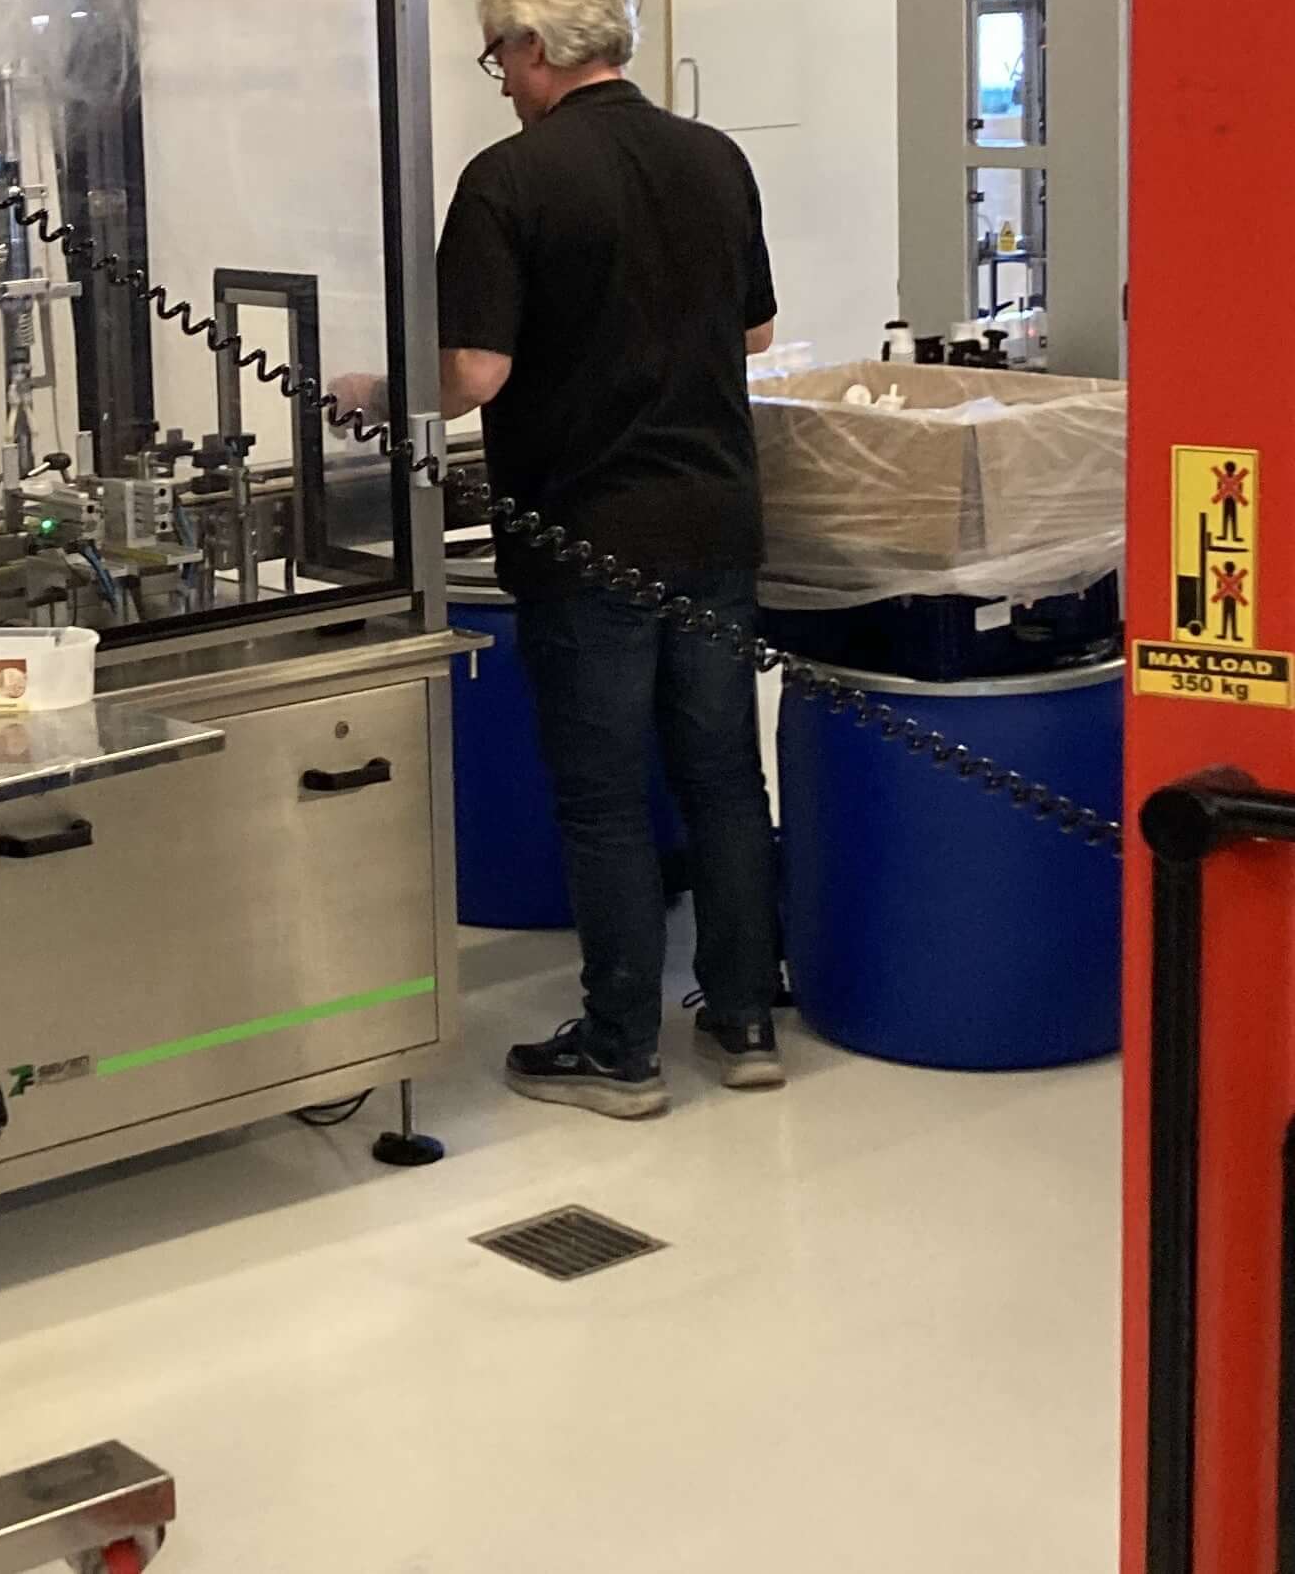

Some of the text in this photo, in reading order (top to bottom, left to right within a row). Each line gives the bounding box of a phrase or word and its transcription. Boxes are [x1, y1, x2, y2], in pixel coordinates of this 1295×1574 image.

[1148, 651, 1273, 675] MAX LOAD
[1171, 674, 1249, 700] 350 kg
